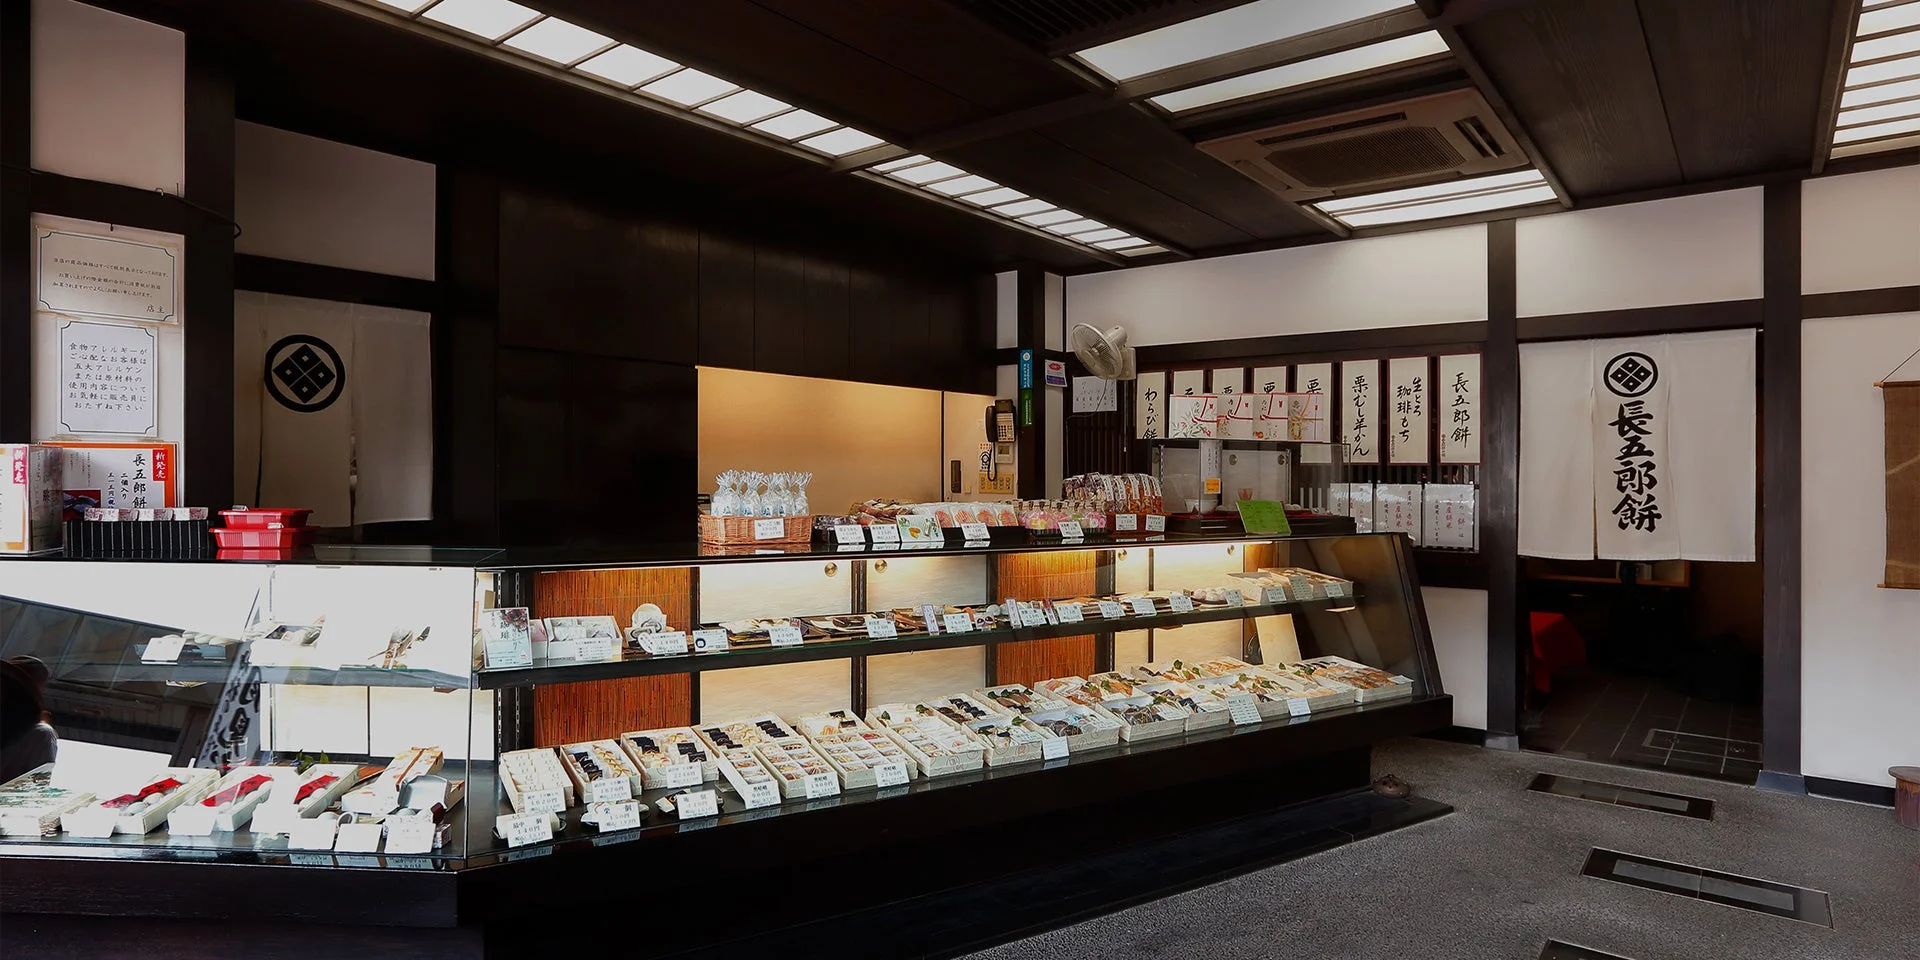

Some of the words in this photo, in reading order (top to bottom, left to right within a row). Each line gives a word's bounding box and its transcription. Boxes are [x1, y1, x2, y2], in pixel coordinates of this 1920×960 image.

[146, 304, 165, 314] 店主
[69, 342, 147, 355] 食物アレルギーが
[70, 352, 147, 364] ご心配なお客様は
[74, 363, 142, 373] 五大アレルゲン
[75, 373, 143, 382] または原材料の
[68, 382, 147, 393] 使用内容について
[69, 392, 147, 402] お気軽に販売員に
[1412, 376, 1423, 417] 生とろ
[74, 402, 143, 411] おたずね下さい
[1352, 375, 1370, 456] 栗むし羊かん
[1396, 385, 1412, 443] 珈琲もち
[1450, 372, 1472, 448] 長五郎餅
[14, 449, 24, 482] 新発売
[155, 452, 166, 479] 新発売
[1608, 400, 1662, 533] 長五郎餅
[120, 473, 129, 499] 二個入り
[132, 453, 147, 509] 長五郎餅
